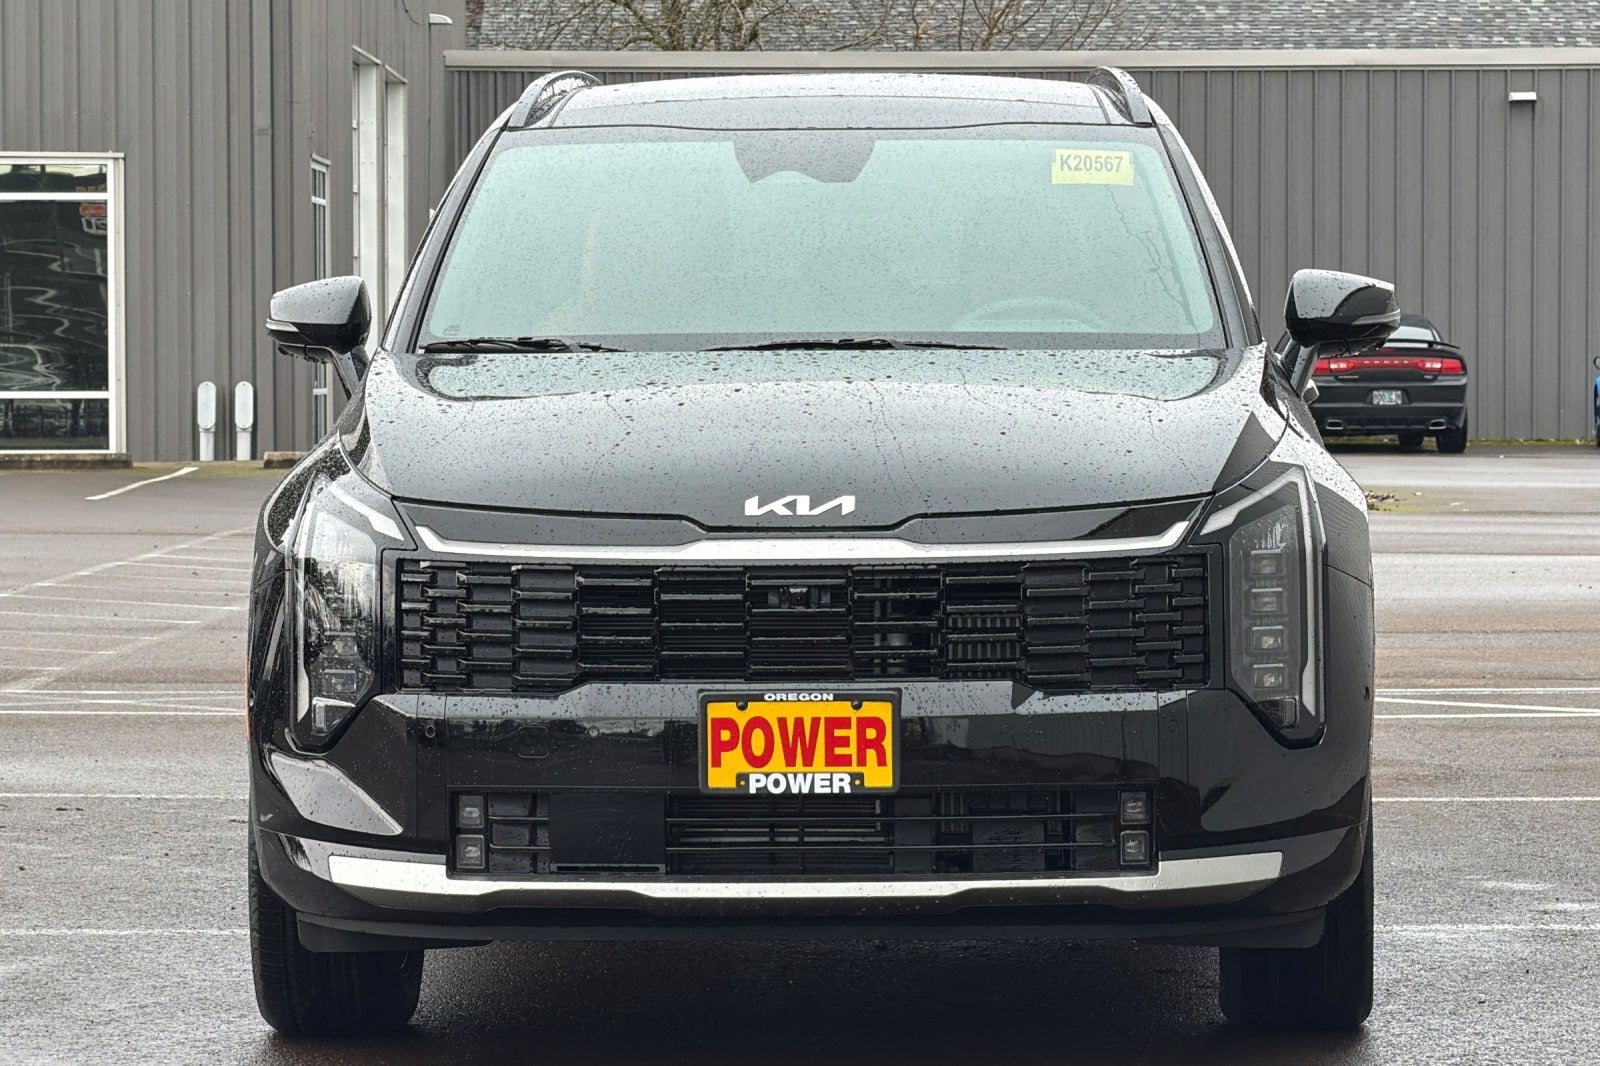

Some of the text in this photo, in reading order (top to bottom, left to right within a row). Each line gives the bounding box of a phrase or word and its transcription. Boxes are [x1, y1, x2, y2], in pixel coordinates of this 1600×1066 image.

[1060, 154, 1123, 172] K20567
[763, 693, 834, 701] OREGON
[711, 716, 888, 769] POWER
[749, 773, 852, 794] POWER
